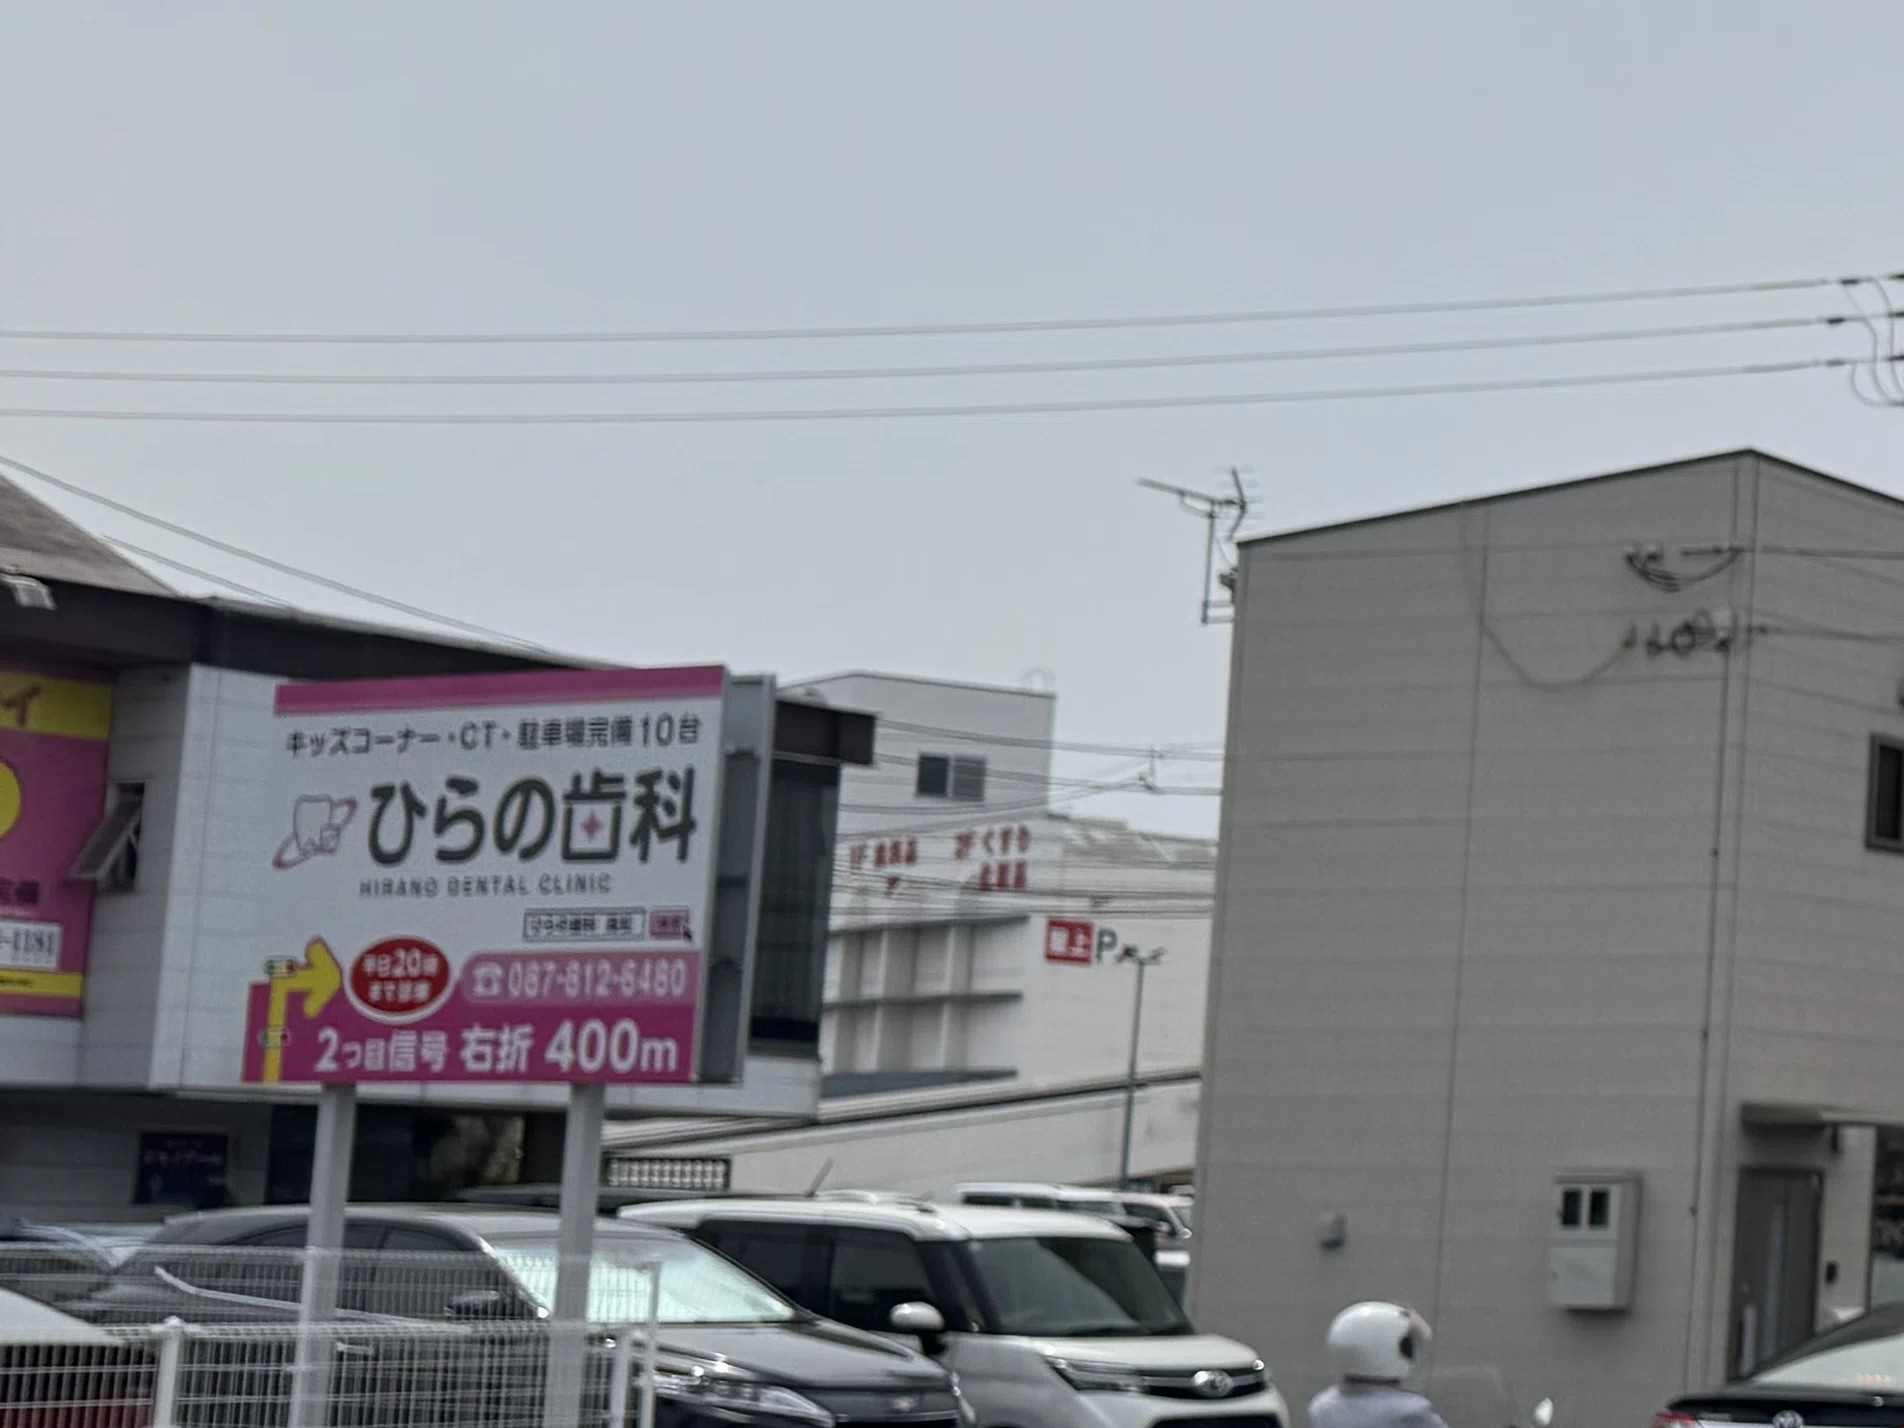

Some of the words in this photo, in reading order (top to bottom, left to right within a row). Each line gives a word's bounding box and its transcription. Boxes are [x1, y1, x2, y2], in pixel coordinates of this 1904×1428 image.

[368, 765, 698, 867] ひらの歯科
[359, 878, 437, 898] HIRANO
[447, 875, 531, 896] DENTAL
[538, 873, 612, 894] CLINIC
[314, 1027, 448, 1072] 2つ目信号
[460, 1021, 534, 1072] 右折
[544, 1017, 678, 1072] 400m
